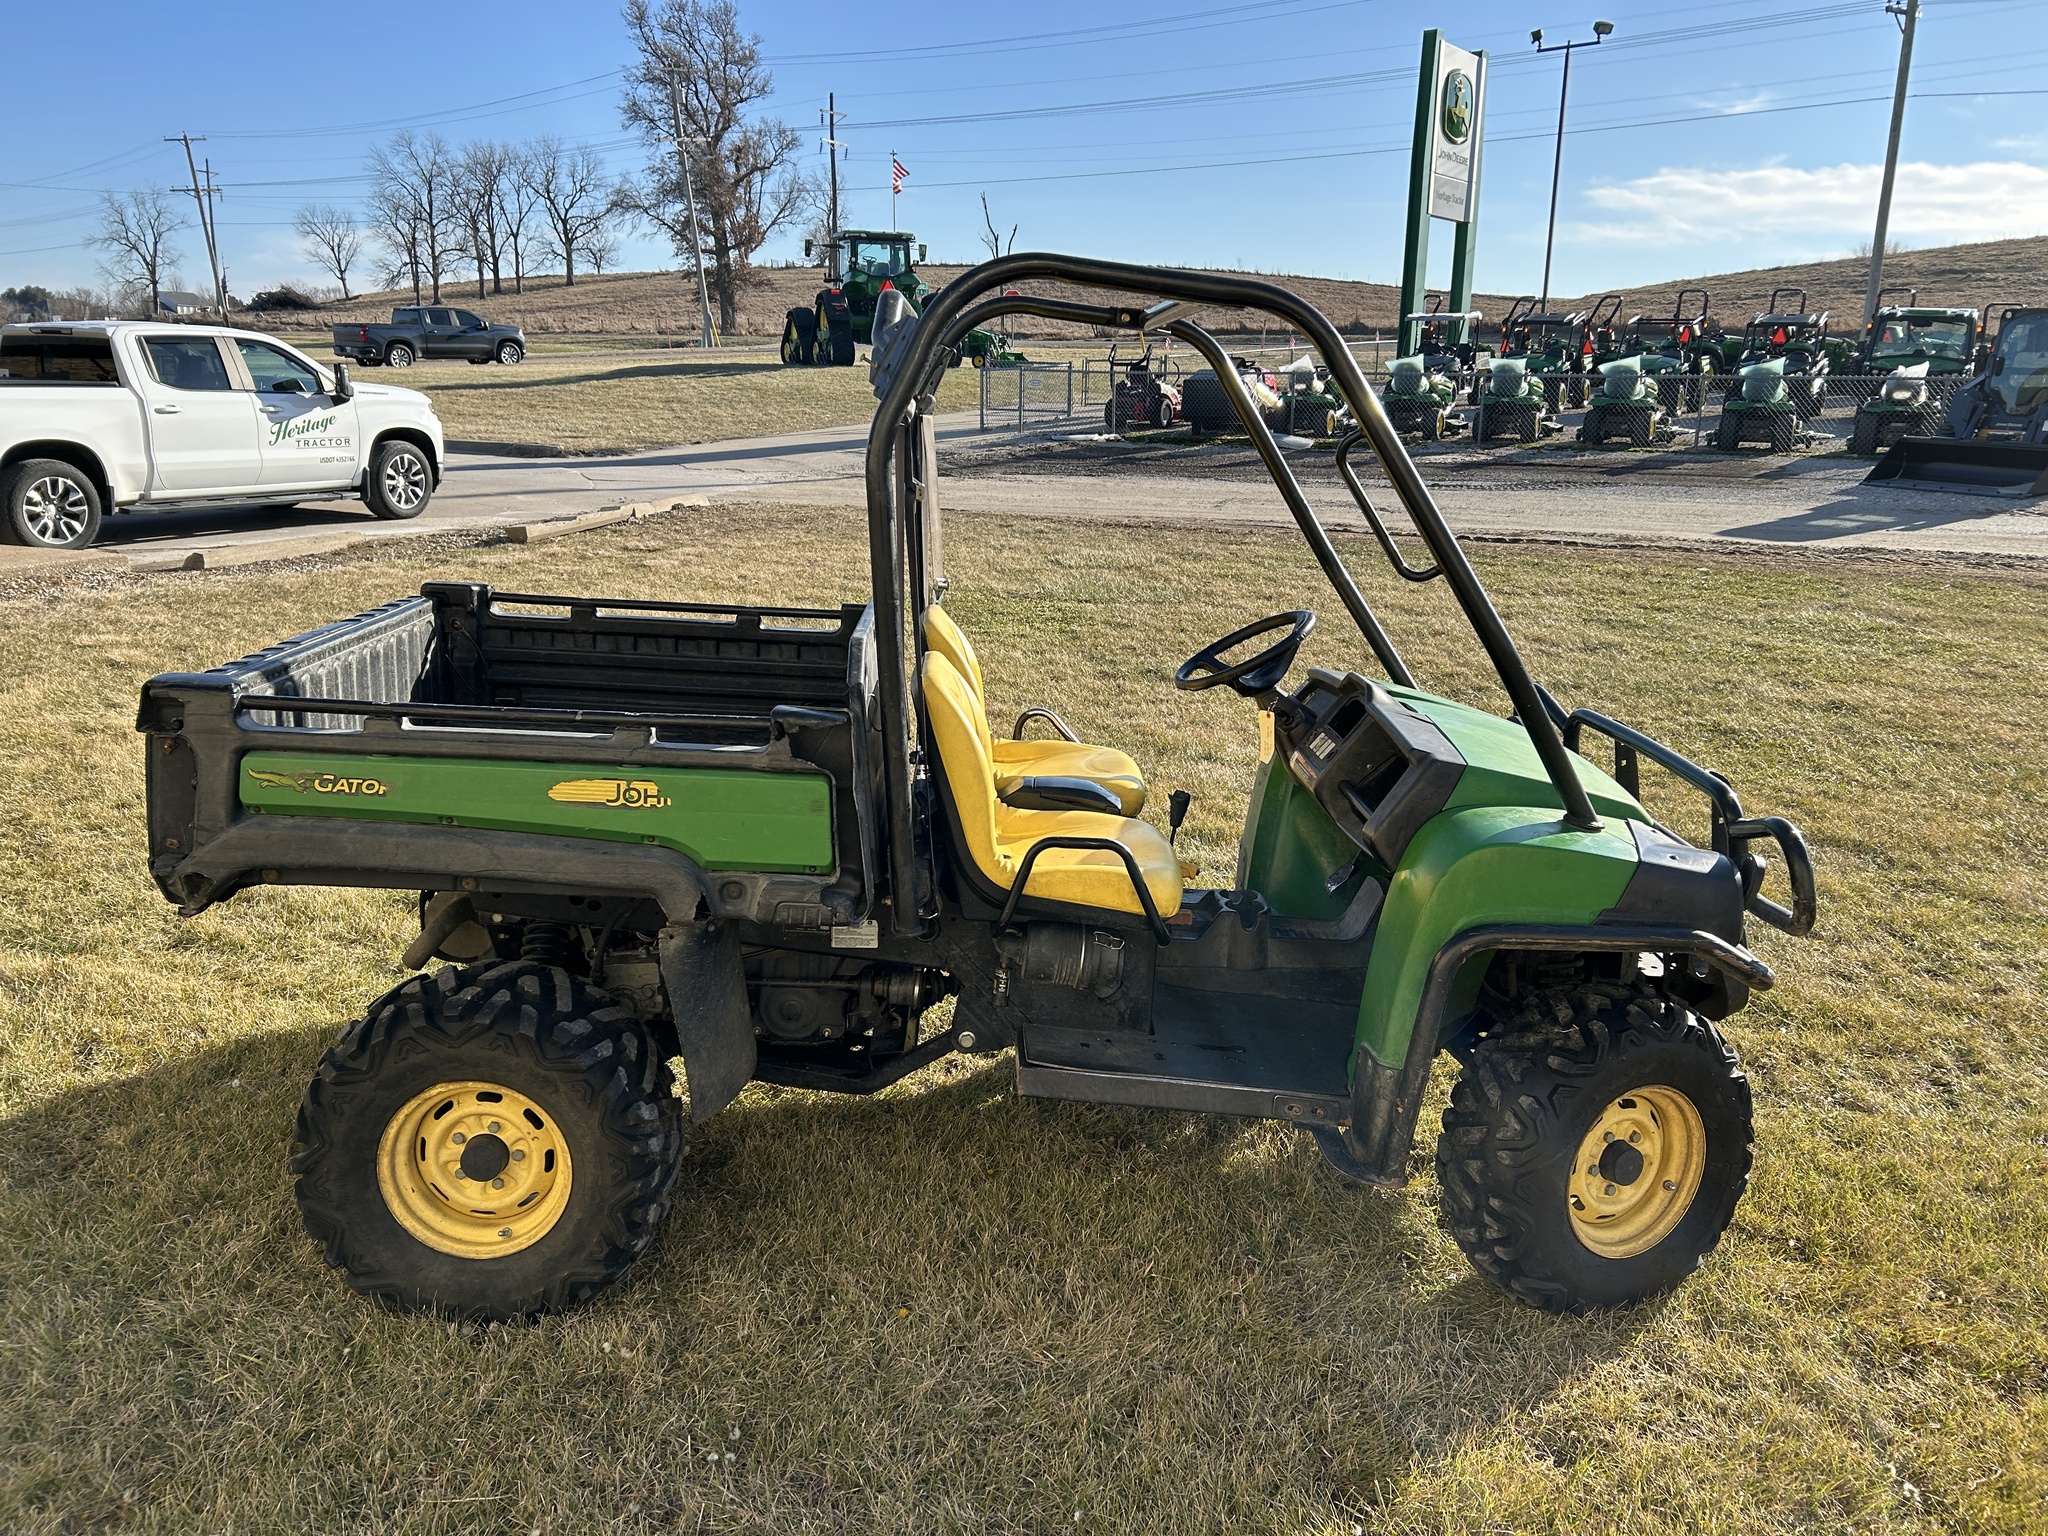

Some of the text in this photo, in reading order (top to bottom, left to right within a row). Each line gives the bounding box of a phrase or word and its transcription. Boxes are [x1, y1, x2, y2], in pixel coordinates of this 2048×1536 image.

[1438, 148, 1469, 167] JOHN DEERE
[1435, 190, 1464, 206] Heritage Tractor
[268, 415, 336, 447] Heritage
[295, 438, 351, 448] TRACTOR
[319, 456, 335, 464] USDOT
